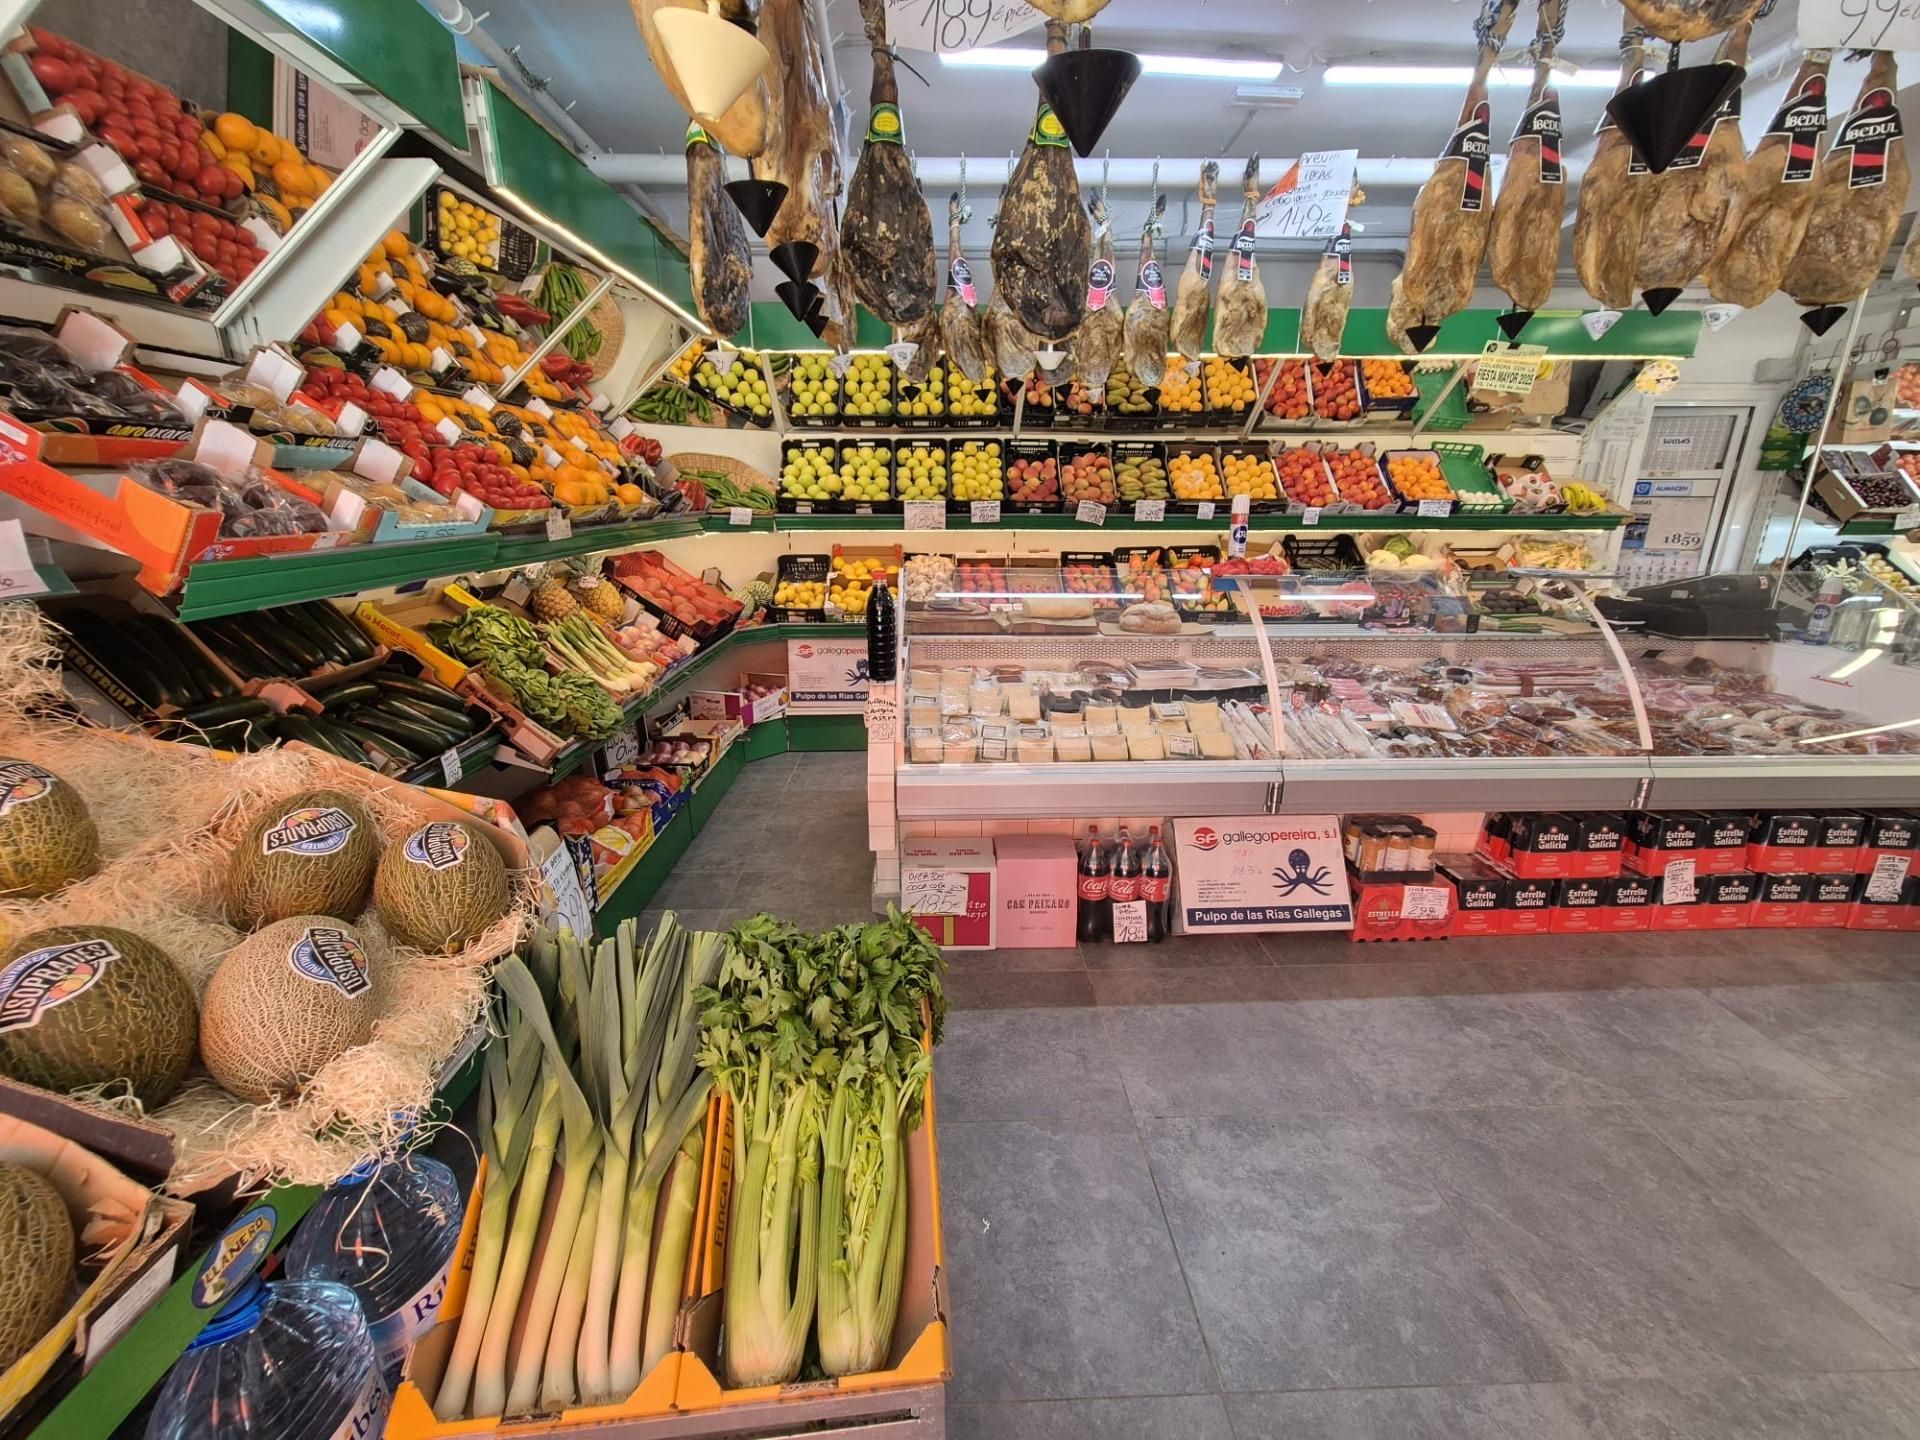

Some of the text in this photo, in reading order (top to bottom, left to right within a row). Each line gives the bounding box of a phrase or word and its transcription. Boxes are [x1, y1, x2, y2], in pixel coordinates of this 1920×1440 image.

[1478, 368, 1497, 381] FIESTA
[796, 692, 816, 701] Pulpo
[270, 811, 350, 847] USOPRADES
[1714, 829, 1744, 837] Estrella
[1777, 828, 1808, 836] Estrella
[1827, 828, 1857, 837] Estrella
[1538, 832, 1569, 841] Estrella
[1588, 832, 1619, 841] Estrella
[1666, 831, 1695, 839] Estrella
[1879, 829, 1910, 839] Estrella
[1666, 839, 1693, 847] Galicia
[1714, 837, 1742, 845] Galicia
[1777, 835, 1805, 844] Galicia
[1826, 836, 1854, 844] Galicia
[1878, 837, 1907, 846] Galicia
[1538, 841, 1567, 850] Galicia
[1588, 840, 1617, 849] Galicia
[1568, 889, 1598, 897] Estrella
[1617, 887, 1647, 896] Estrella
[1719, 885, 1749, 893] Estrella
[1771, 884, 1801, 893] Estrella
[1820, 884, 1850, 893] Estrella
[1466, 891, 1496, 900] Estrella
[1515, 890, 1546, 899] Estrella
[1718, 893, 1746, 901] Galicia
[1770, 892, 1798, 900] Galicia
[1819, 892, 1846, 900] Galicia
[1007, 899, 1070, 909] CAN PAIXANO
[1466, 899, 1494, 907] Galicia
[1516, 898, 1544, 906] Galicia
[1568, 896, 1596, 905] Galicia
[1617, 895, 1645, 904] Galicia
[1195, 911, 1228, 923] Pulpo
[1231, 911, 1244, 921] de
[1247, 910, 1263, 921] las
[1293, 908, 1342, 921] Gallegas
[314, 929, 363, 991] USOPRADES
[0, 944, 108, 1021] USOPRADES
[721, 1151, 733, 1170] El
[715, 1182, 728, 1248] Finca
[205, 1216, 263, 1284] LLANERO
[411, 1273, 447, 1326] Ri
